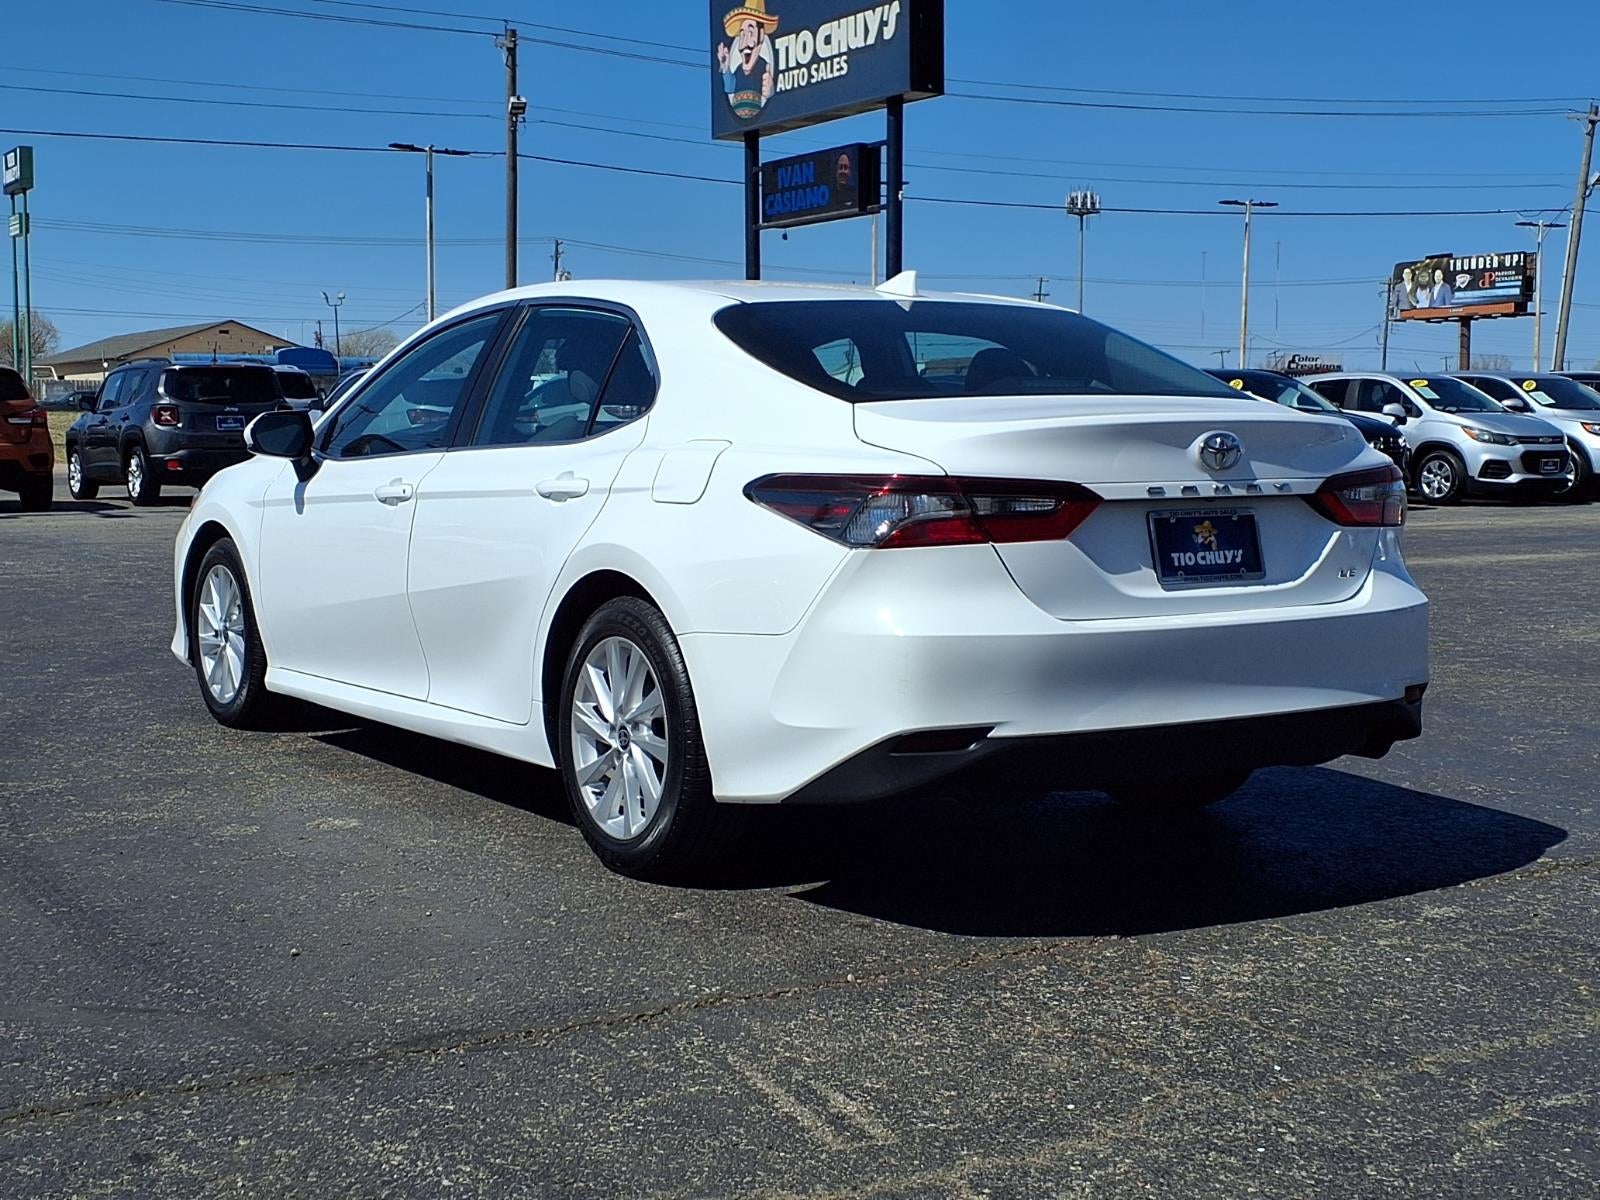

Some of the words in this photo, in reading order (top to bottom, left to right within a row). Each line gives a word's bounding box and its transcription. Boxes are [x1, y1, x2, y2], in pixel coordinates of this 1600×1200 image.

[775, 30, 814, 71] TIO
[816, 1, 900, 57] CHUY'S
[776, 66, 808, 92] AUTO
[811, 55, 849, 82] SALES
[778, 162, 814, 189] IVAN
[765, 186, 829, 215] CASIANO
[1450, 256, 1498, 271] THUNDER
[1505, 253, 1525, 267] UP!
[1287, 360, 1343, 370] Creations
[1291, 353, 1320, 363] Color
[1171, 552, 1195, 567] TIO
[1196, 549, 1244, 565] CHUY'S
[1337, 568, 1357, 579] LE
